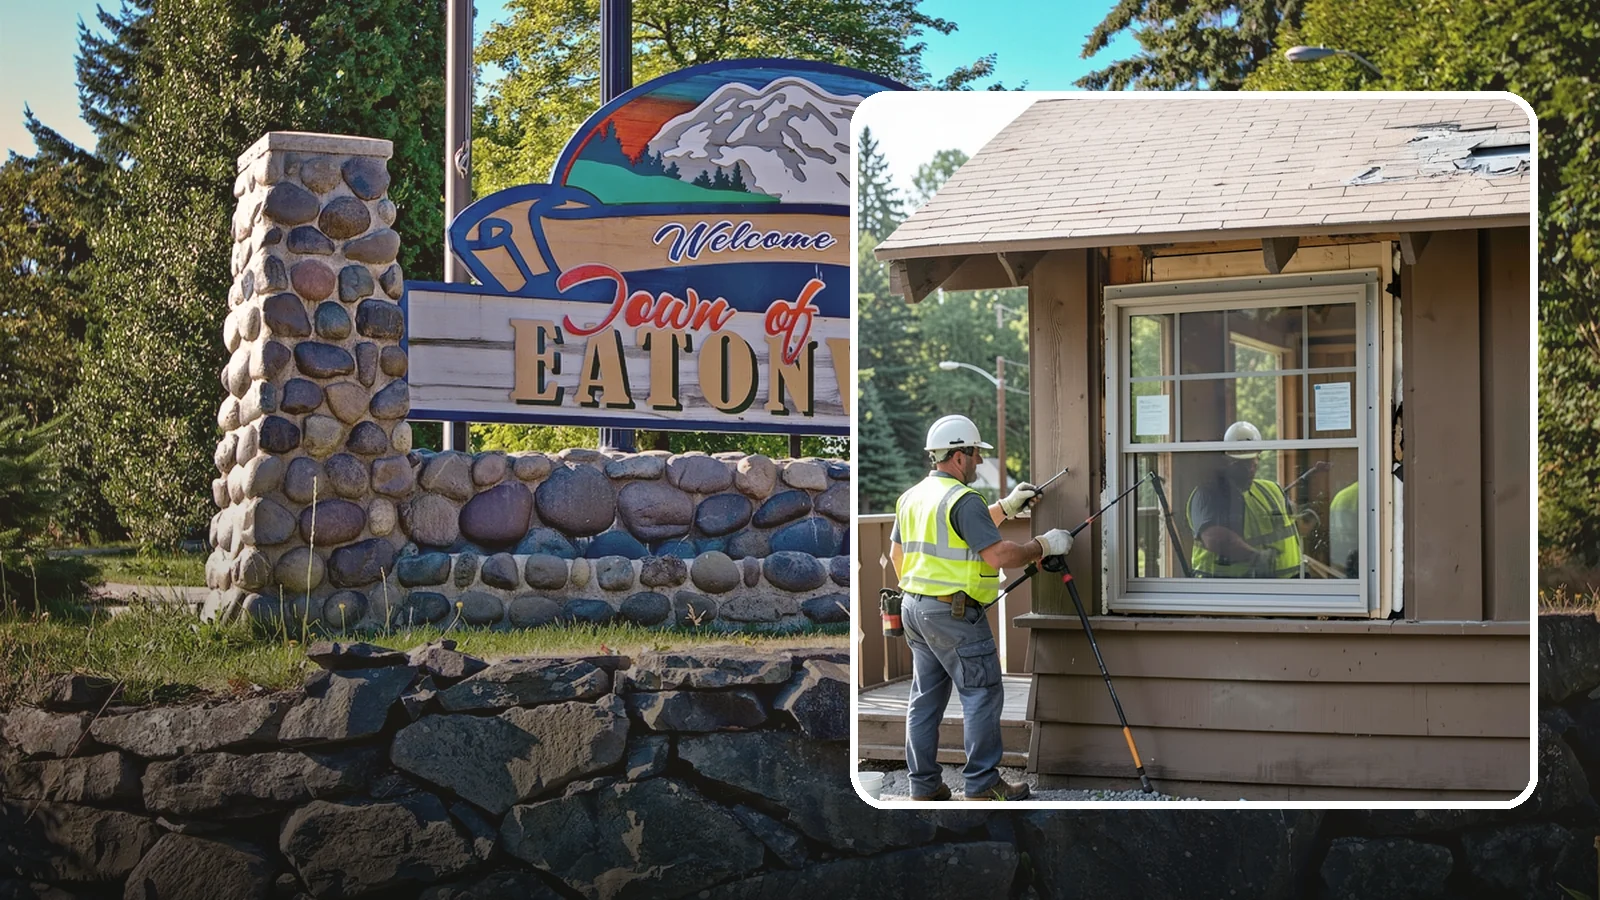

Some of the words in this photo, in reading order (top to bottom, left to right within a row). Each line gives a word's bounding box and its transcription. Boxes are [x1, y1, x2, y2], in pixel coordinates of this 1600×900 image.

[653, 220, 837, 263] Welcome
[556, 263, 737, 336] Town
[764, 278, 826, 366] of
